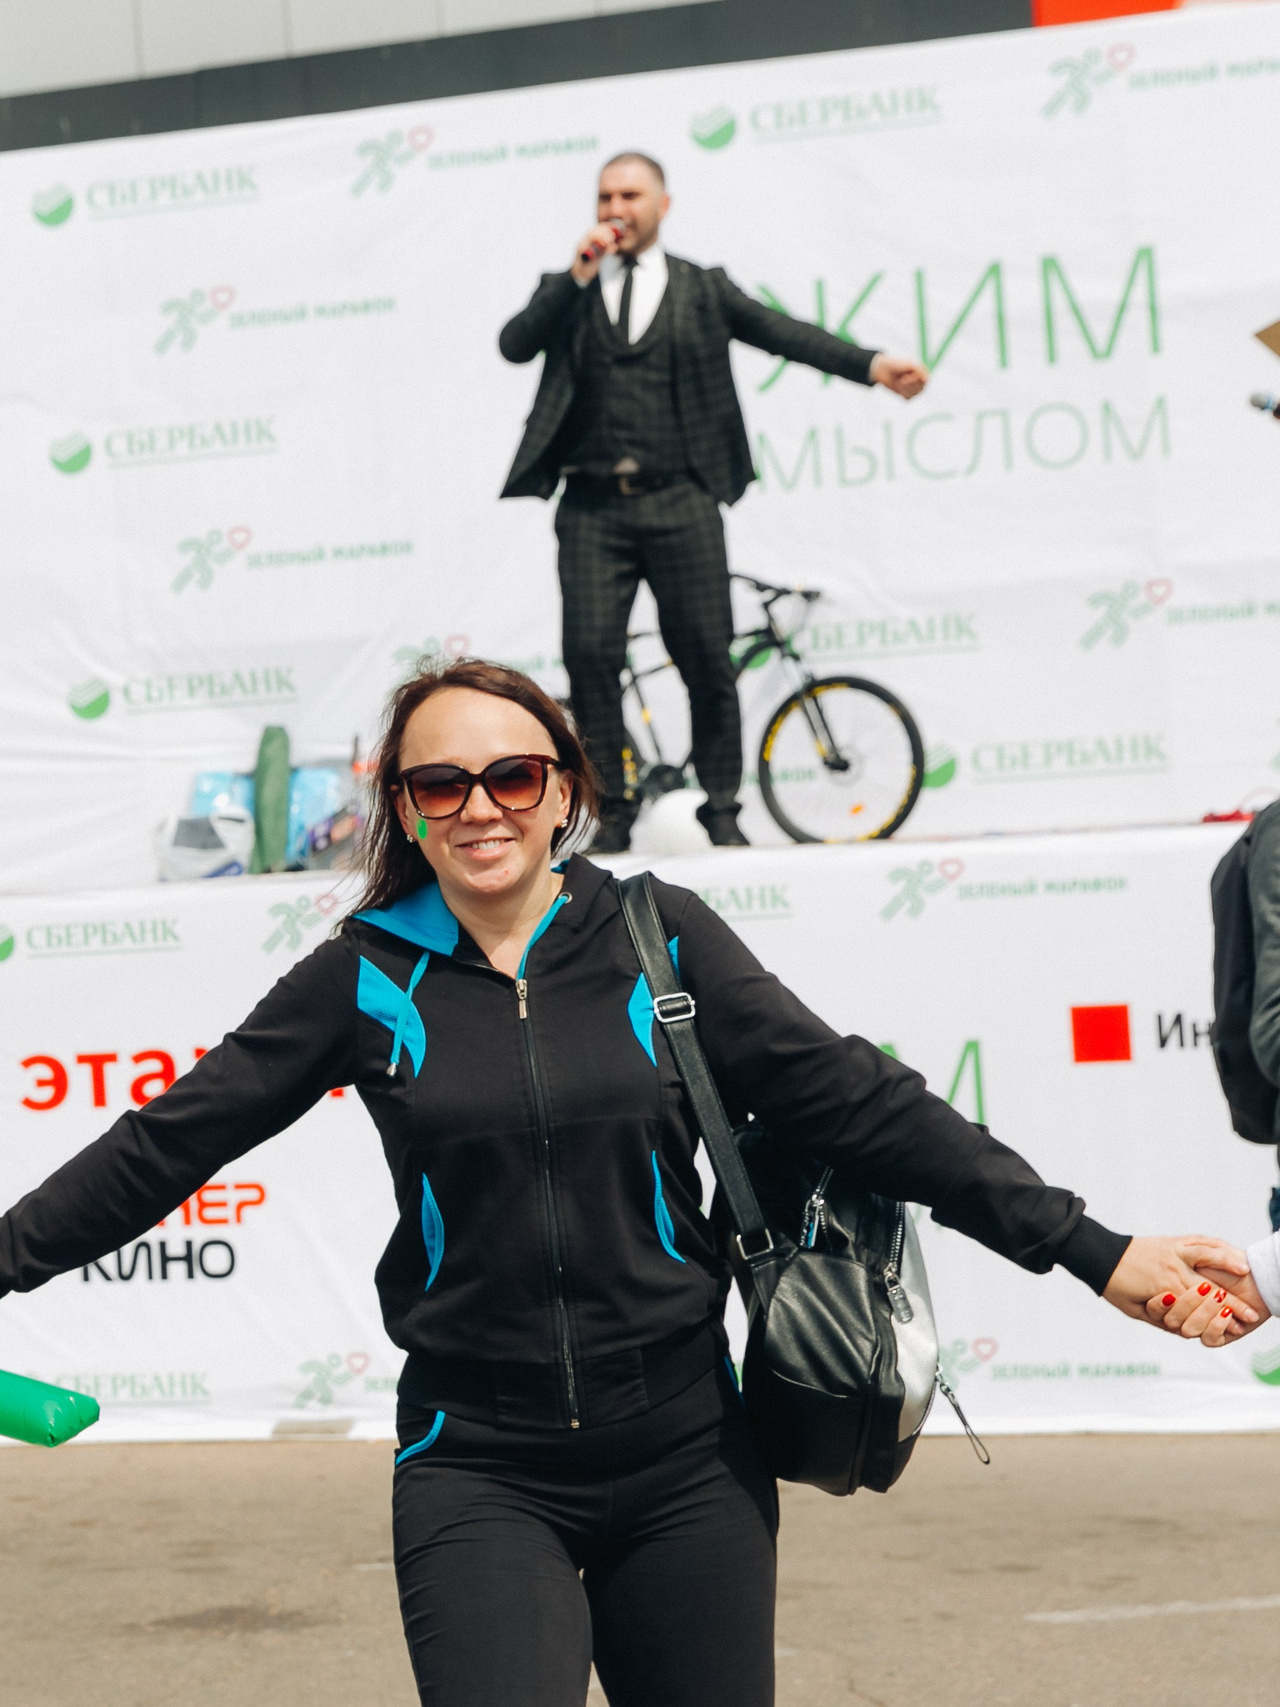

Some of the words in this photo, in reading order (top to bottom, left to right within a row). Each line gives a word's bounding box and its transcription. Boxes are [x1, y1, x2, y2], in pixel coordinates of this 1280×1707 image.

[748, 84, 942, 136] СБЕРБАНК
[85, 165, 260, 212] СБЕРБАНК
[103, 414, 278, 460] СБЕРБАНК
[756, 395, 1172, 492] МЫСЛОМ
[122, 665, 298, 706] СБЕРБАНК
[970, 733, 1167, 775] СБЕРБАНК
[24, 917, 182, 951] СБЕРБАНК
